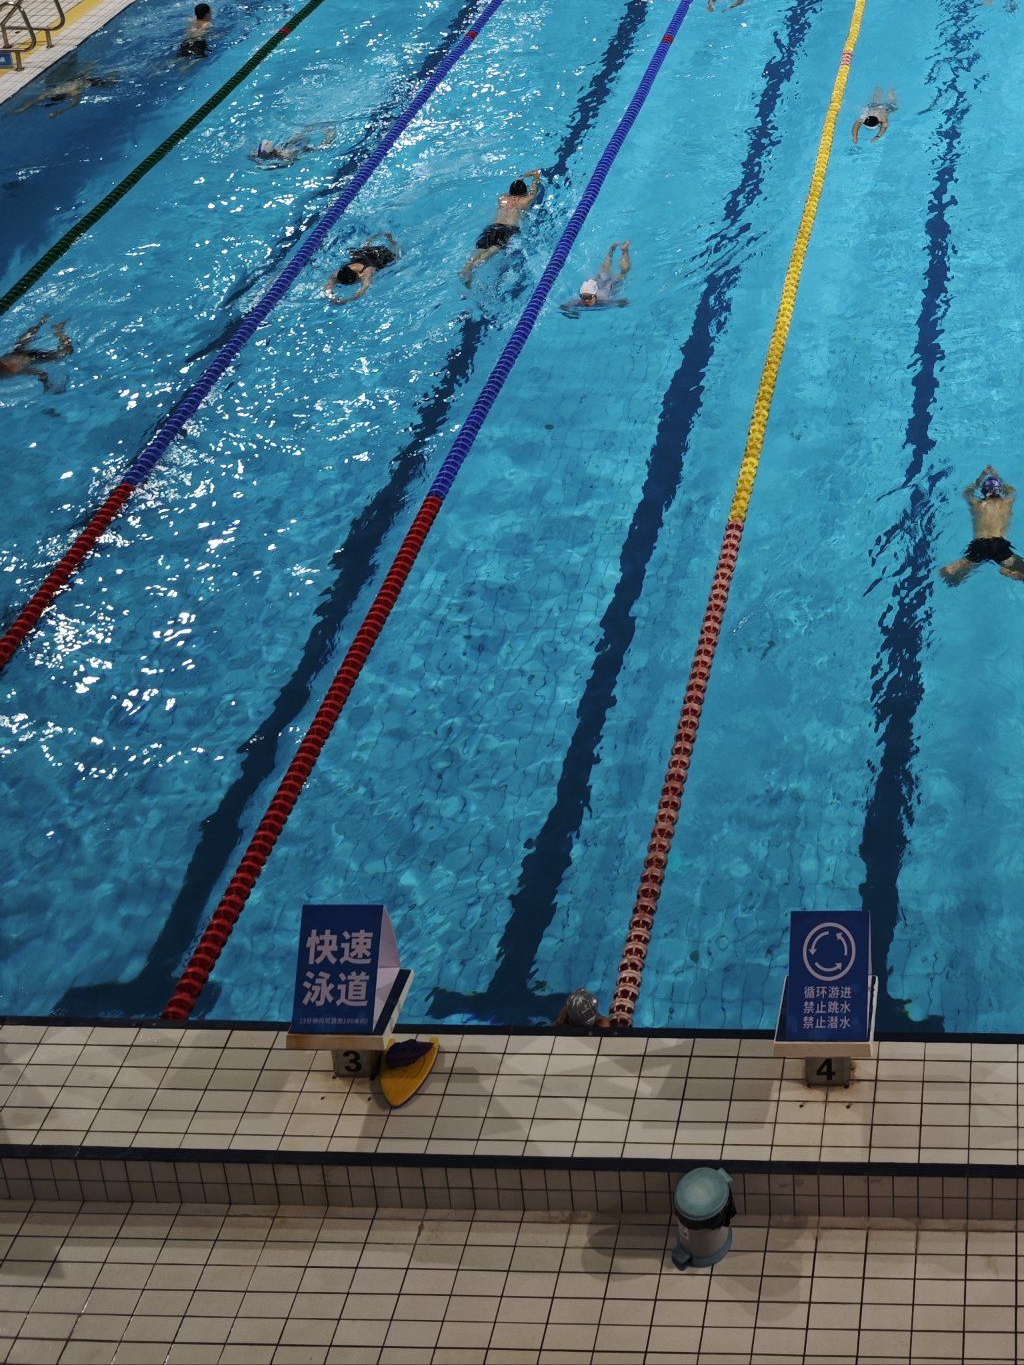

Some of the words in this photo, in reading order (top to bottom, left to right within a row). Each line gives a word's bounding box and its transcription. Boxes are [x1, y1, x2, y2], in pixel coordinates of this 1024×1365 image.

[306, 929, 374, 965] 快速
[302, 970, 371, 1007] 泳道
[804, 985, 852, 999] 循环游进
[803, 1000, 852, 1014] 禁止跳水
[802, 1016, 851, 1029] 禁止潜水
[344, 1050, 362, 1073] 3
[816, 1058, 836, 1081] 4
